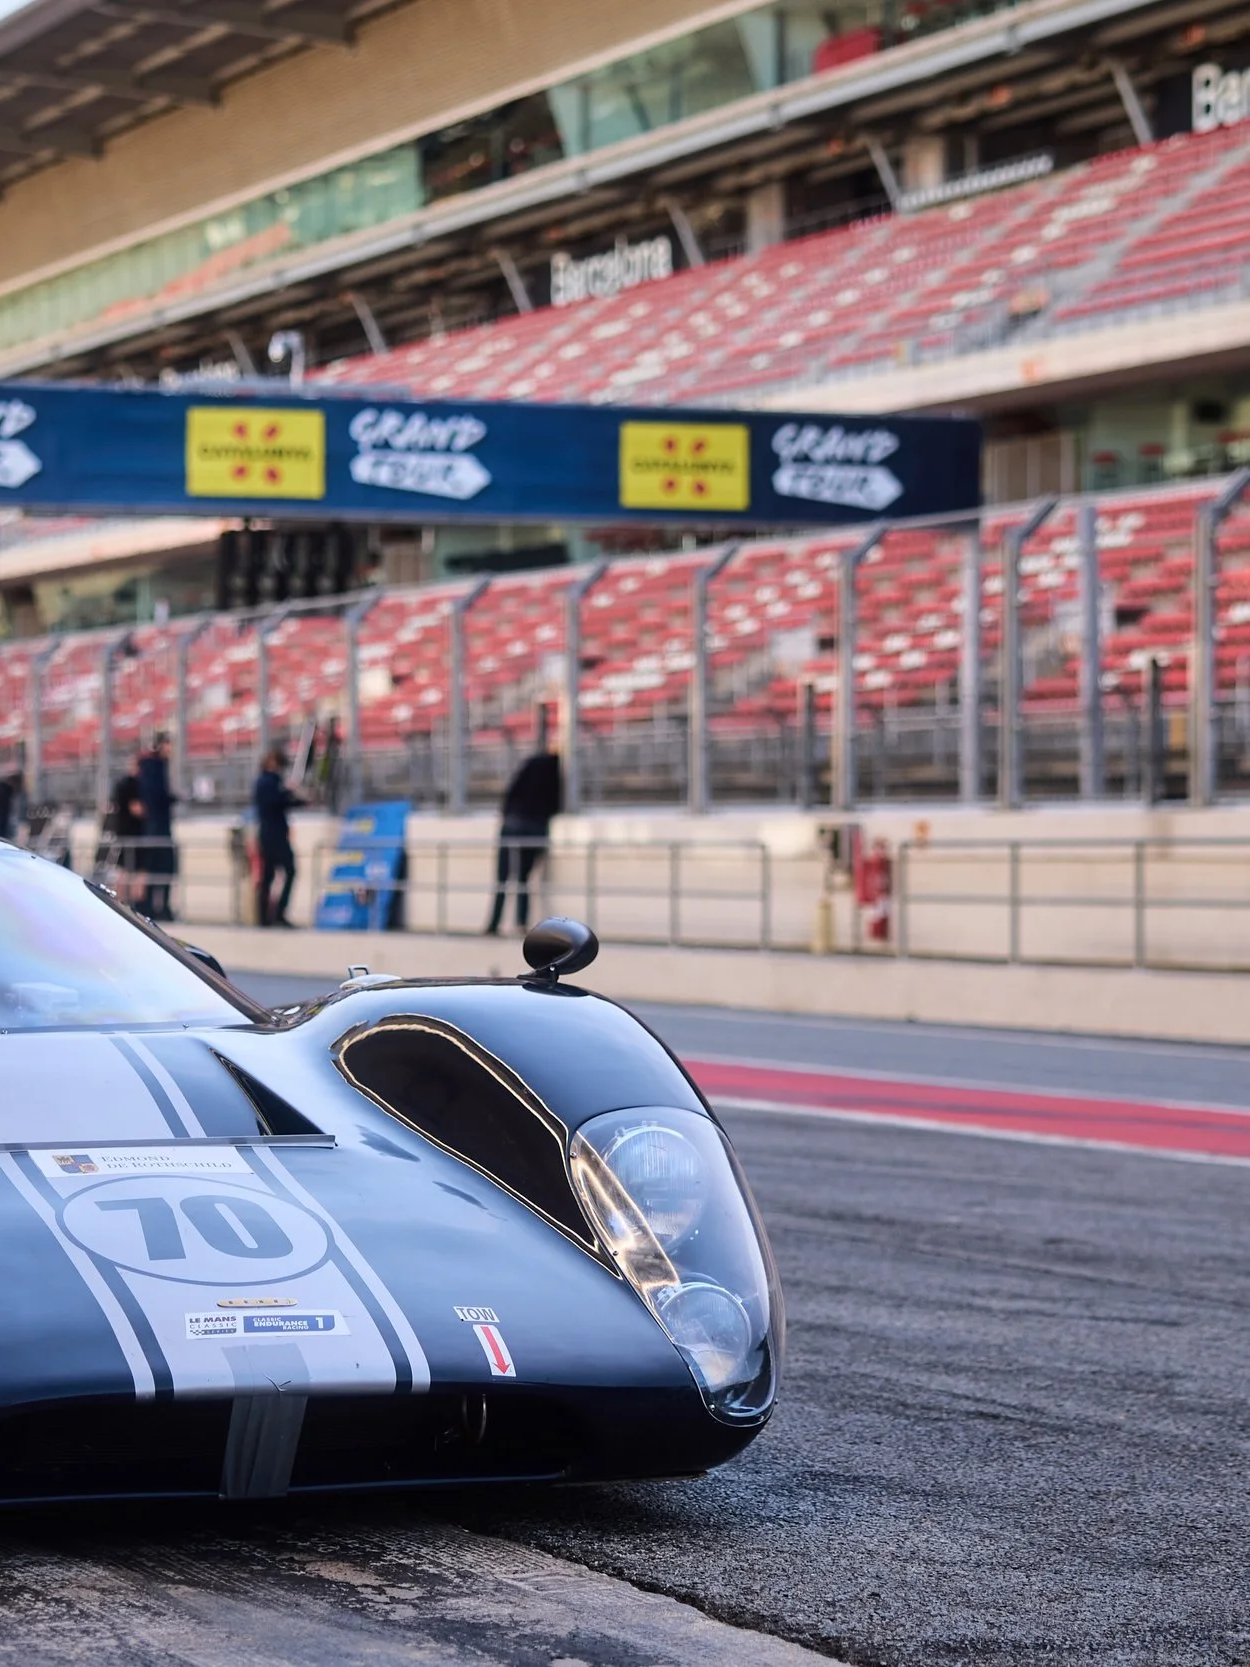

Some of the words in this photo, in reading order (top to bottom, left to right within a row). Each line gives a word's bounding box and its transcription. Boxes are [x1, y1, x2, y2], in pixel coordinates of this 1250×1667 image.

[348, 408, 487, 452] GRAND
[771, 423, 899, 465] GRAND
[133, 1161, 232, 1169] ROTHSCHILD
[94, 1195, 293, 1261] 70
[203, 1315, 237, 1323] MANS
[455, 1307, 496, 1321] TOW
[253, 1320, 308, 1328] ENDURANCE
[315, 1317, 324, 1329] 1
